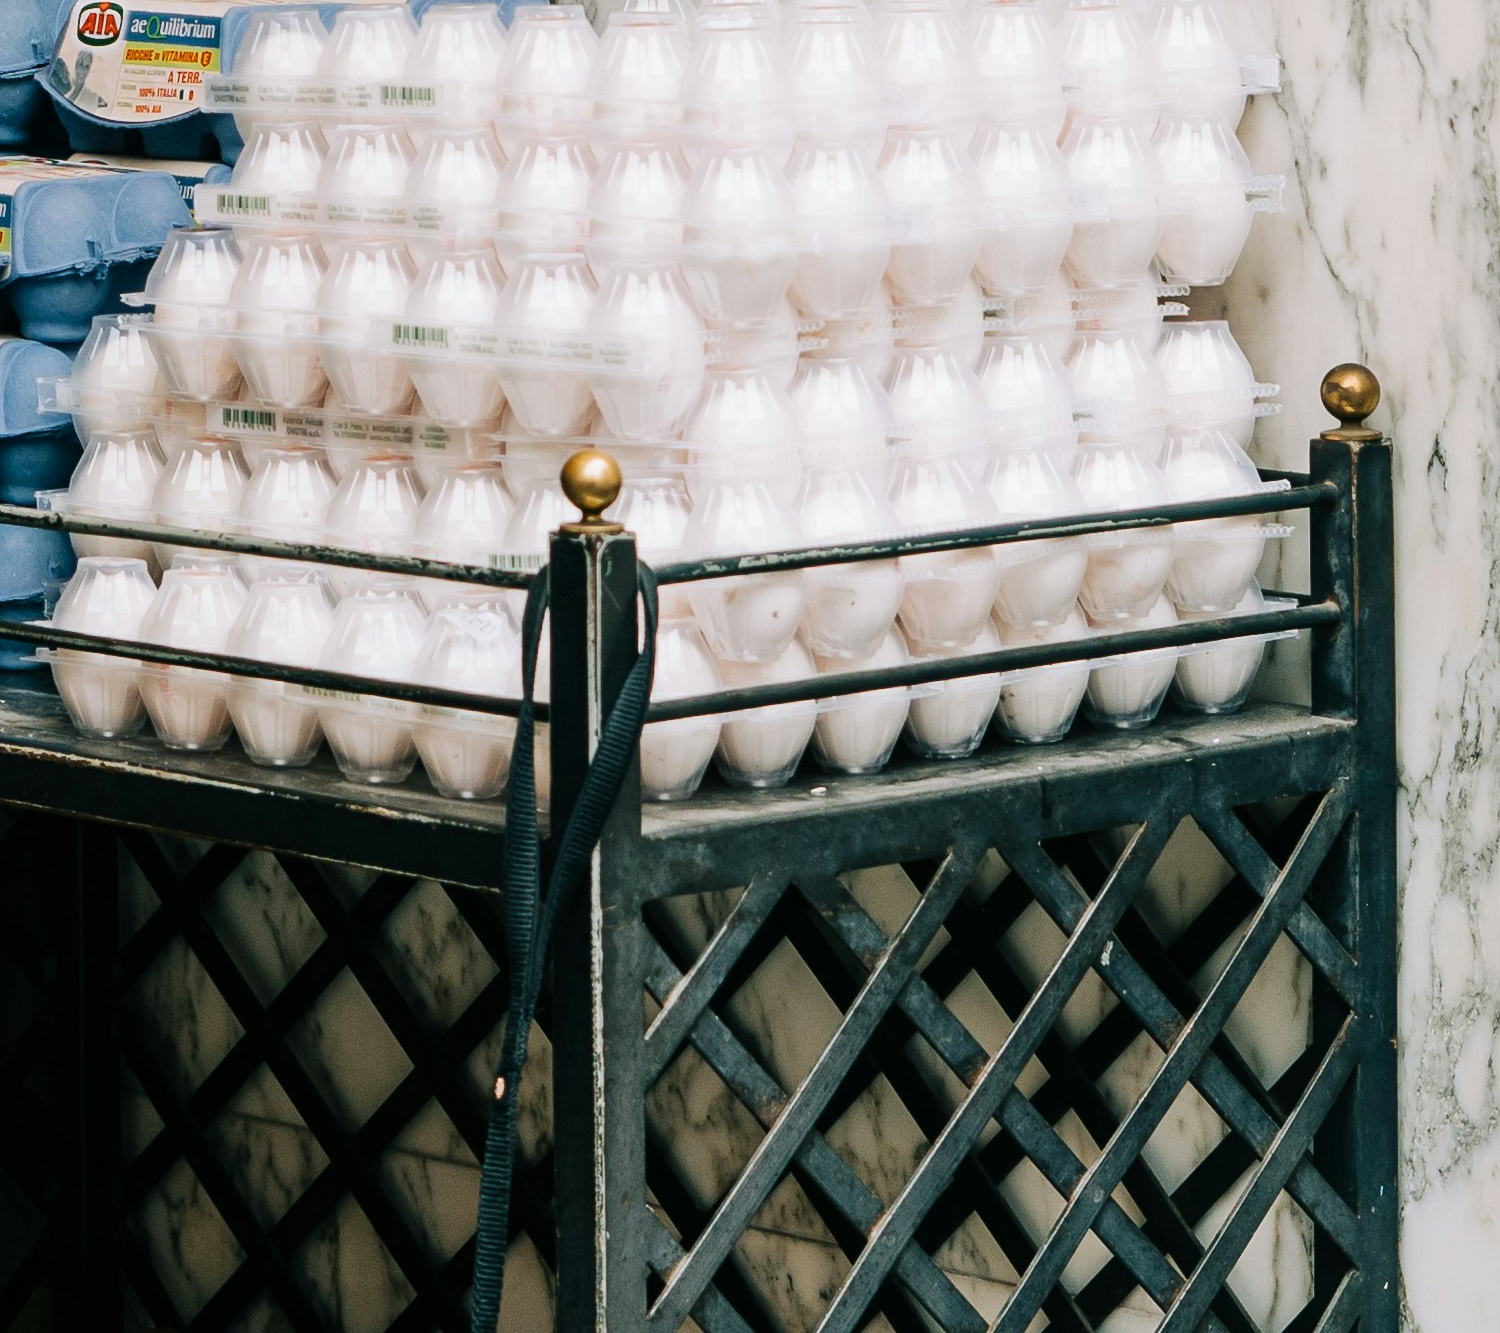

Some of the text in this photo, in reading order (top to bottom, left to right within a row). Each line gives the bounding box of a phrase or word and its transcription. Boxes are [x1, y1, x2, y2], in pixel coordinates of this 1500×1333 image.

[130, 15, 216, 40] aeQuilibrium
[161, 50, 199, 64] VITAMINA
[176, 71, 203, 84] TERR
[156, 88, 177, 98] ITALIA
